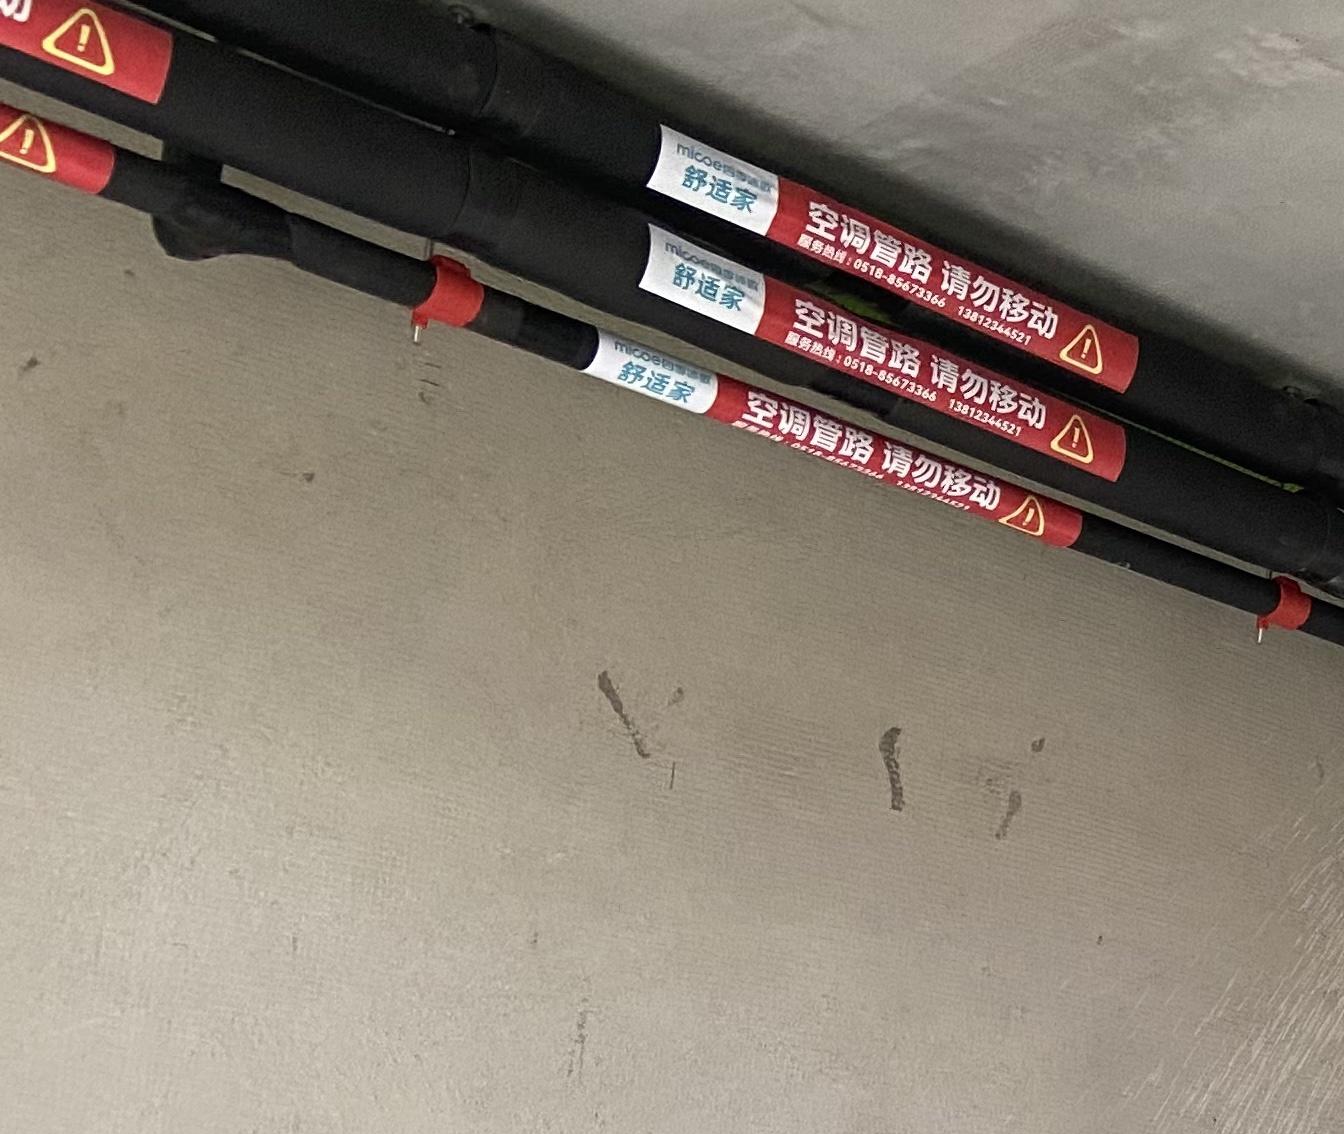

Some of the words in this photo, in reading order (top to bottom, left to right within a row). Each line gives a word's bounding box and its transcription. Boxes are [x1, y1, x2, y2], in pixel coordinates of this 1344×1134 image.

[682, 165, 758, 213] 舒适家
[673, 262, 744, 311] 舒适家
[806, 201, 932, 284] 空调管路
[940, 260, 1058, 340] 请勿移动
[958, 306, 1031, 346] 13812344521
[617, 361, 696, 404] 舒适家
[792, 299, 921, 379] 空调管路
[931, 354, 1047, 430] 请勿移动
[949, 398, 1022, 437] 13812344521
[742, 391, 874, 465] 空调管路
[882, 442, 1001, 511] 请勿移动
